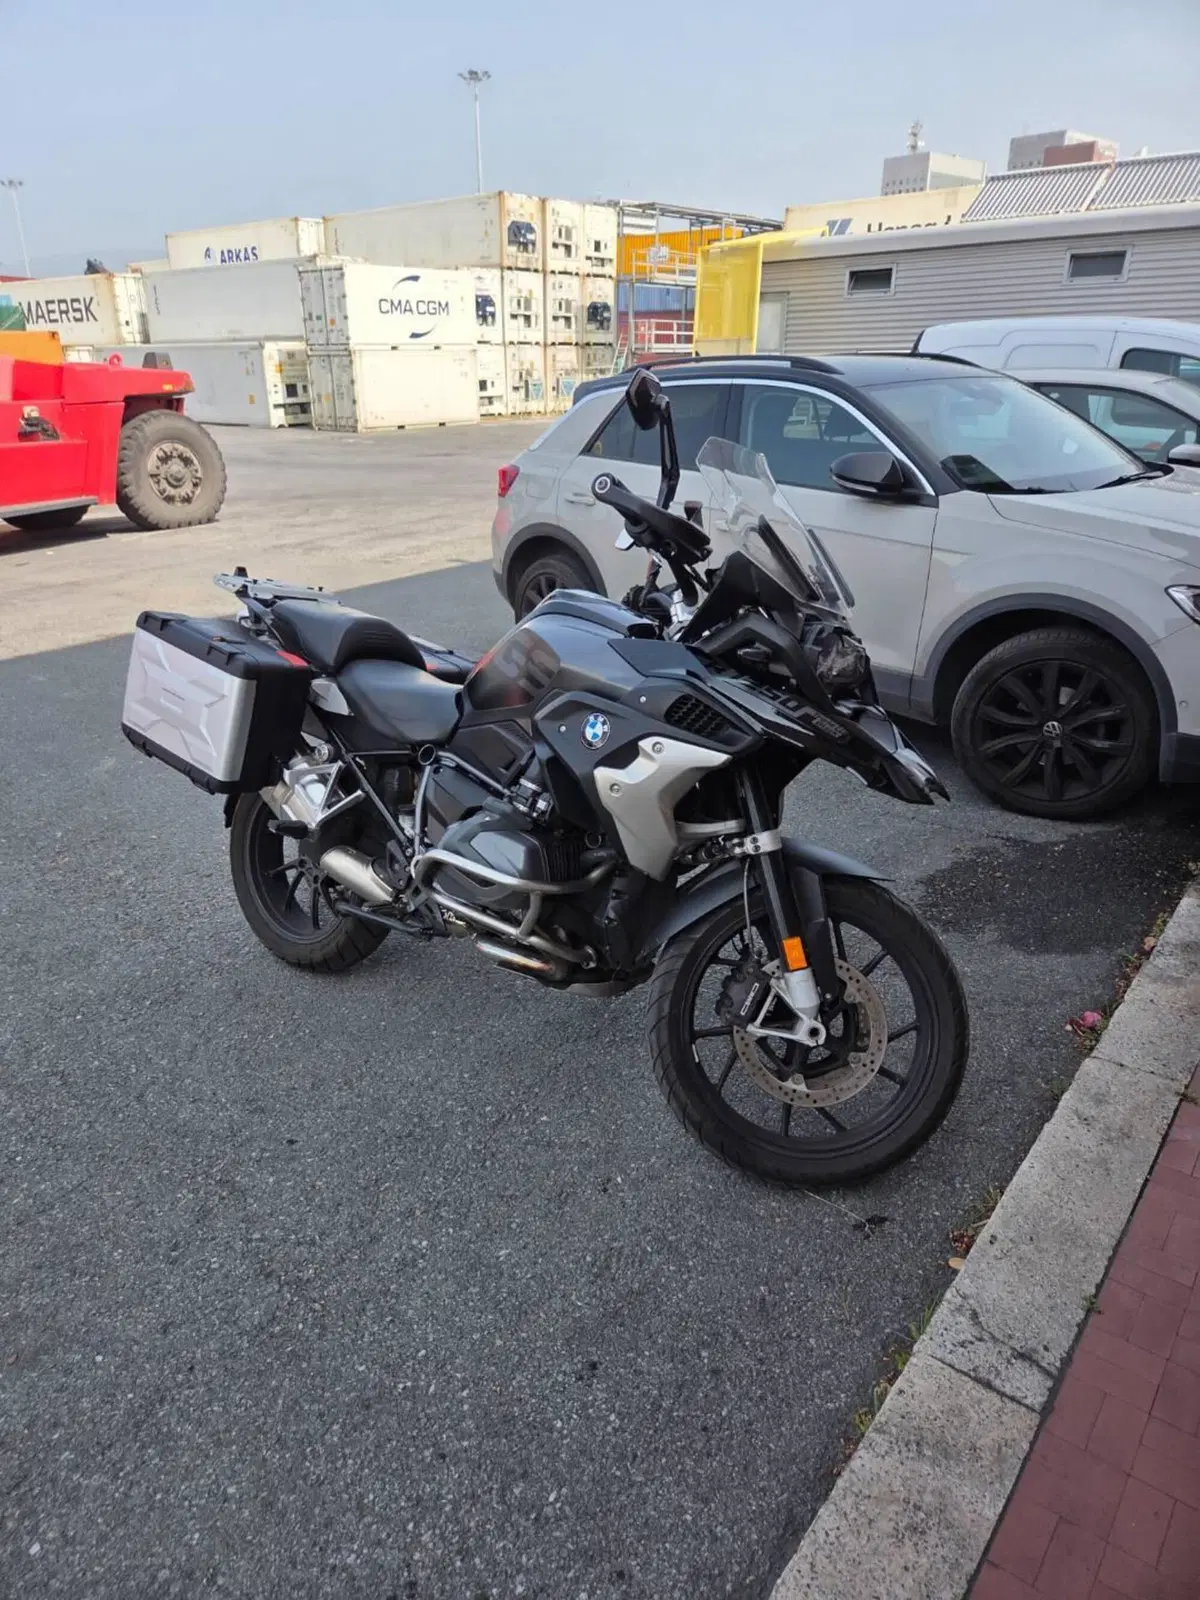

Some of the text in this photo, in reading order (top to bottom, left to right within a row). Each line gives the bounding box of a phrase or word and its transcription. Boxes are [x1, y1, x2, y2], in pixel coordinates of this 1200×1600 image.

[220, 246, 260, 265] ARKAS
[18, 296, 99, 325] MAERSK
[378, 298, 450, 316] CMA CGM
